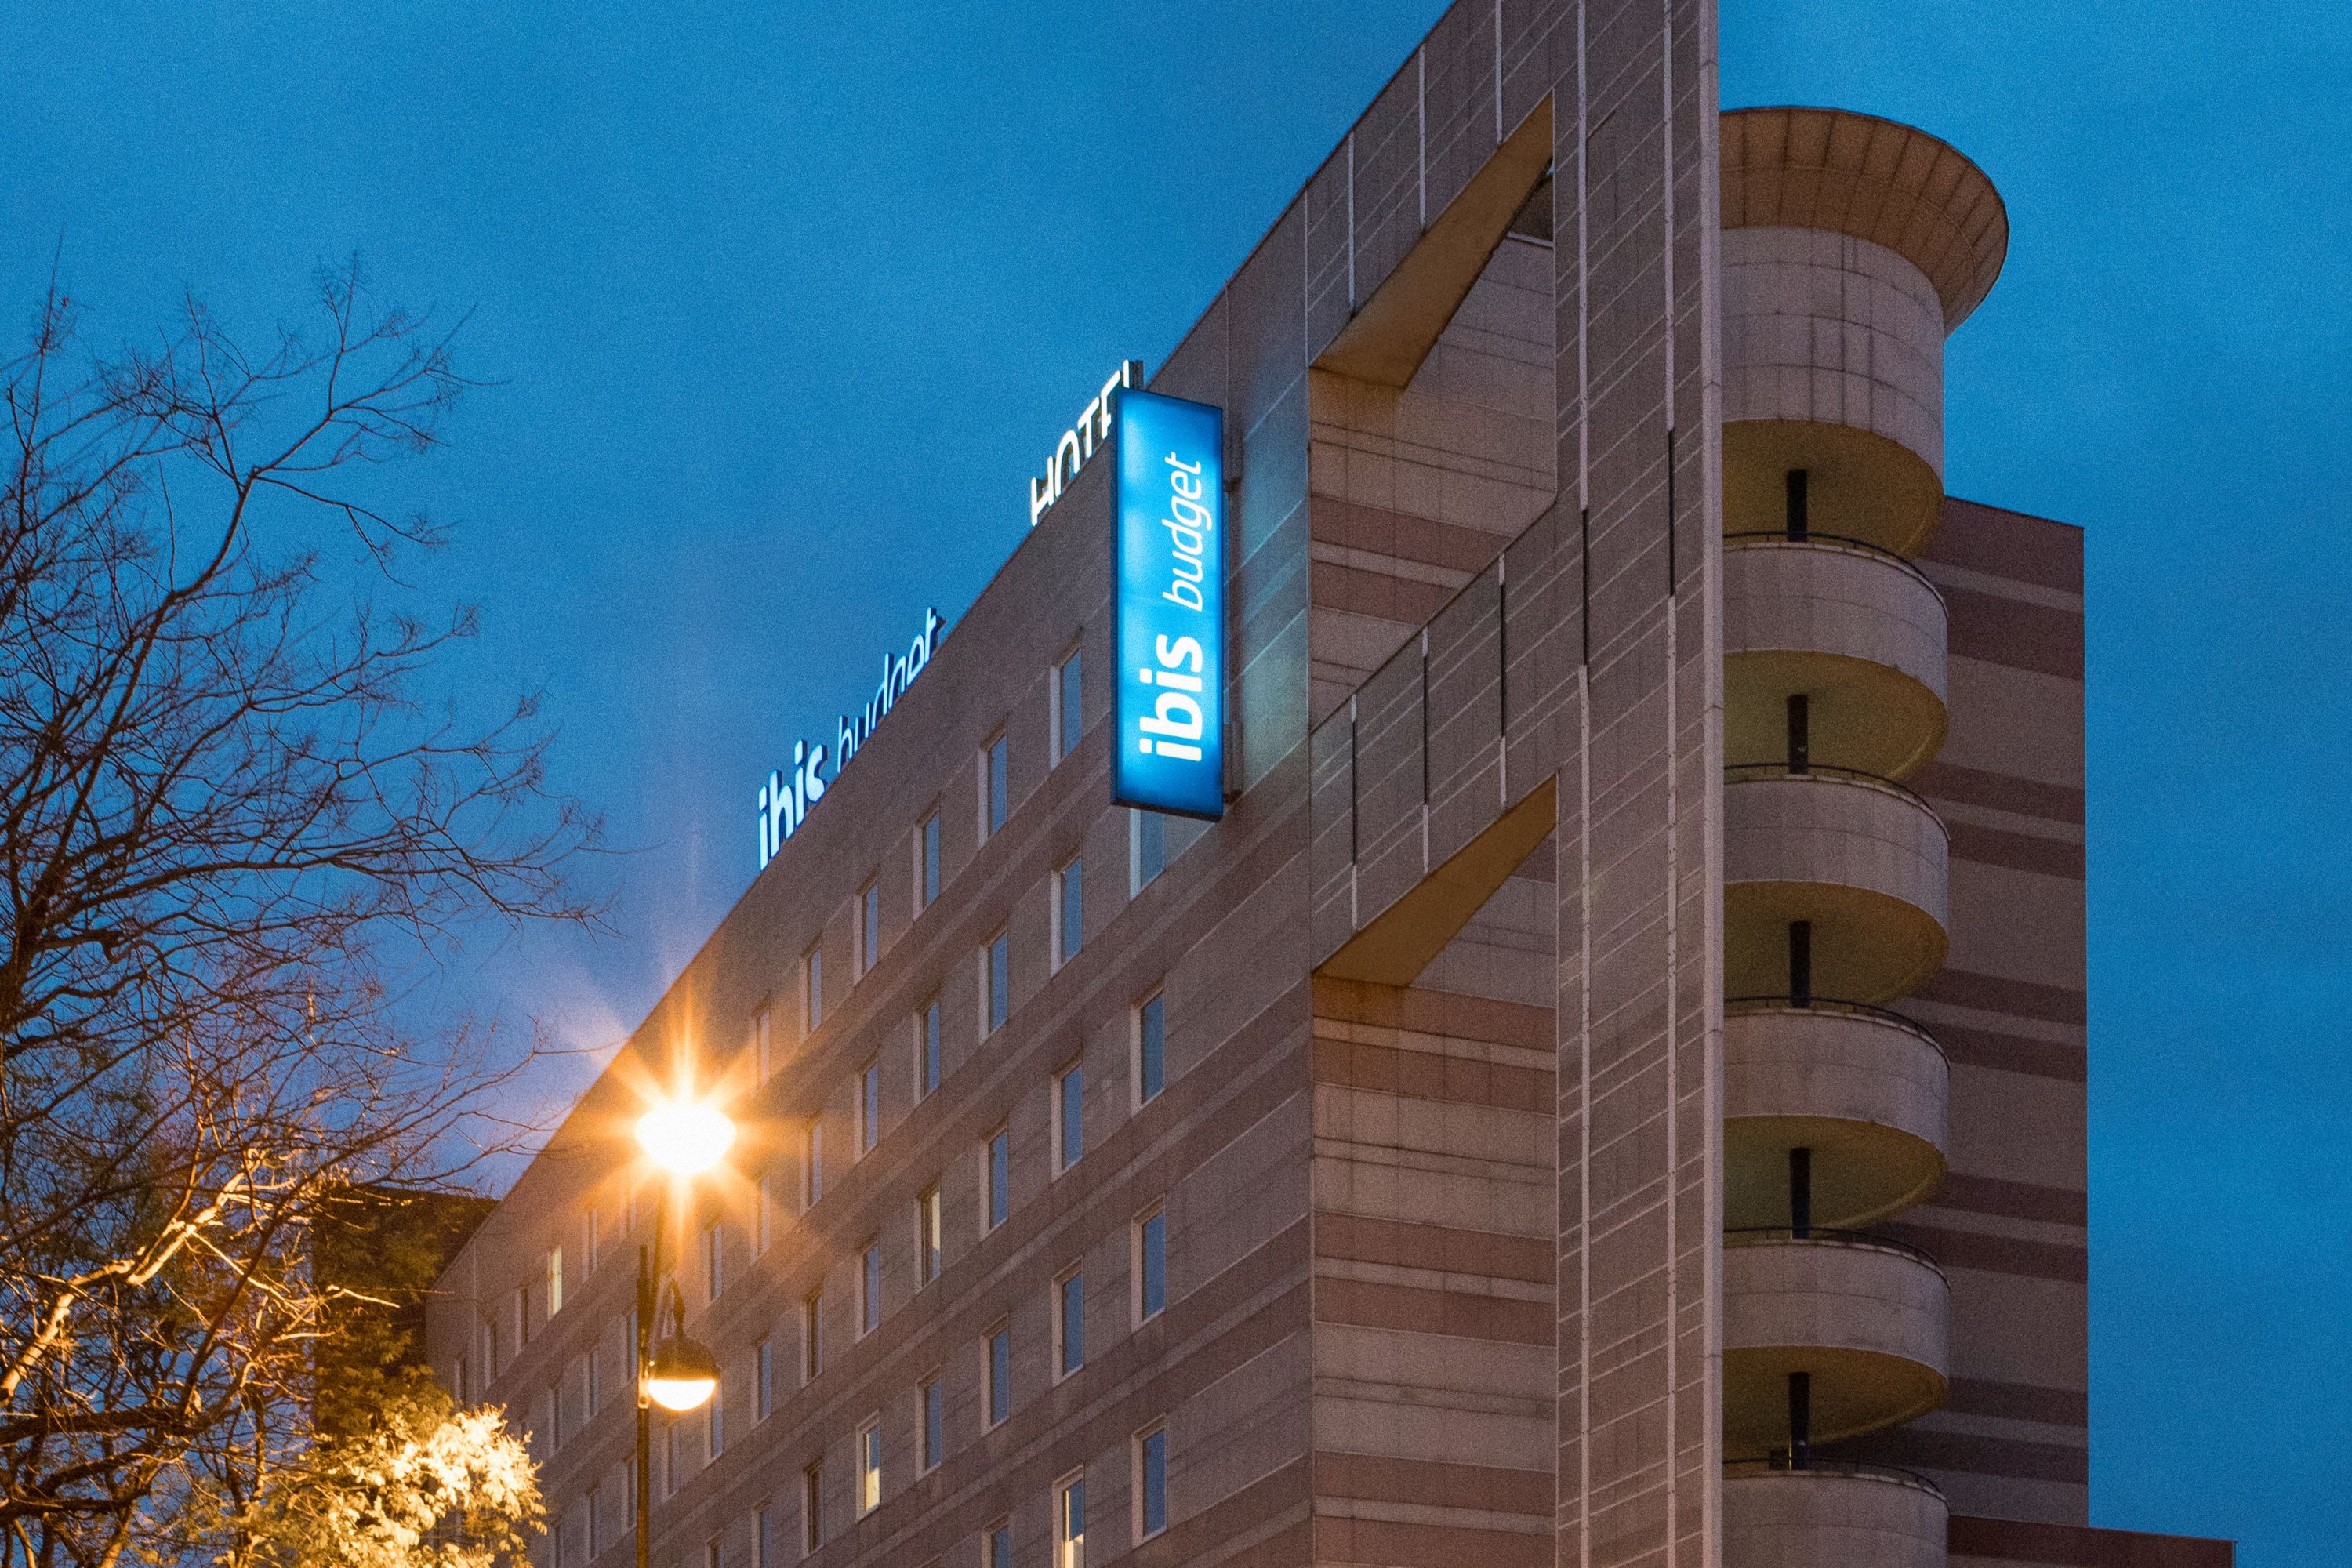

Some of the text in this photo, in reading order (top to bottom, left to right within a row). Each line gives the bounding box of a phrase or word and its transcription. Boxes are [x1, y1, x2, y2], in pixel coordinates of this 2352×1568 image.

[1139, 451, 1213, 762] ibis budget
[758, 739, 826, 872] ibis
